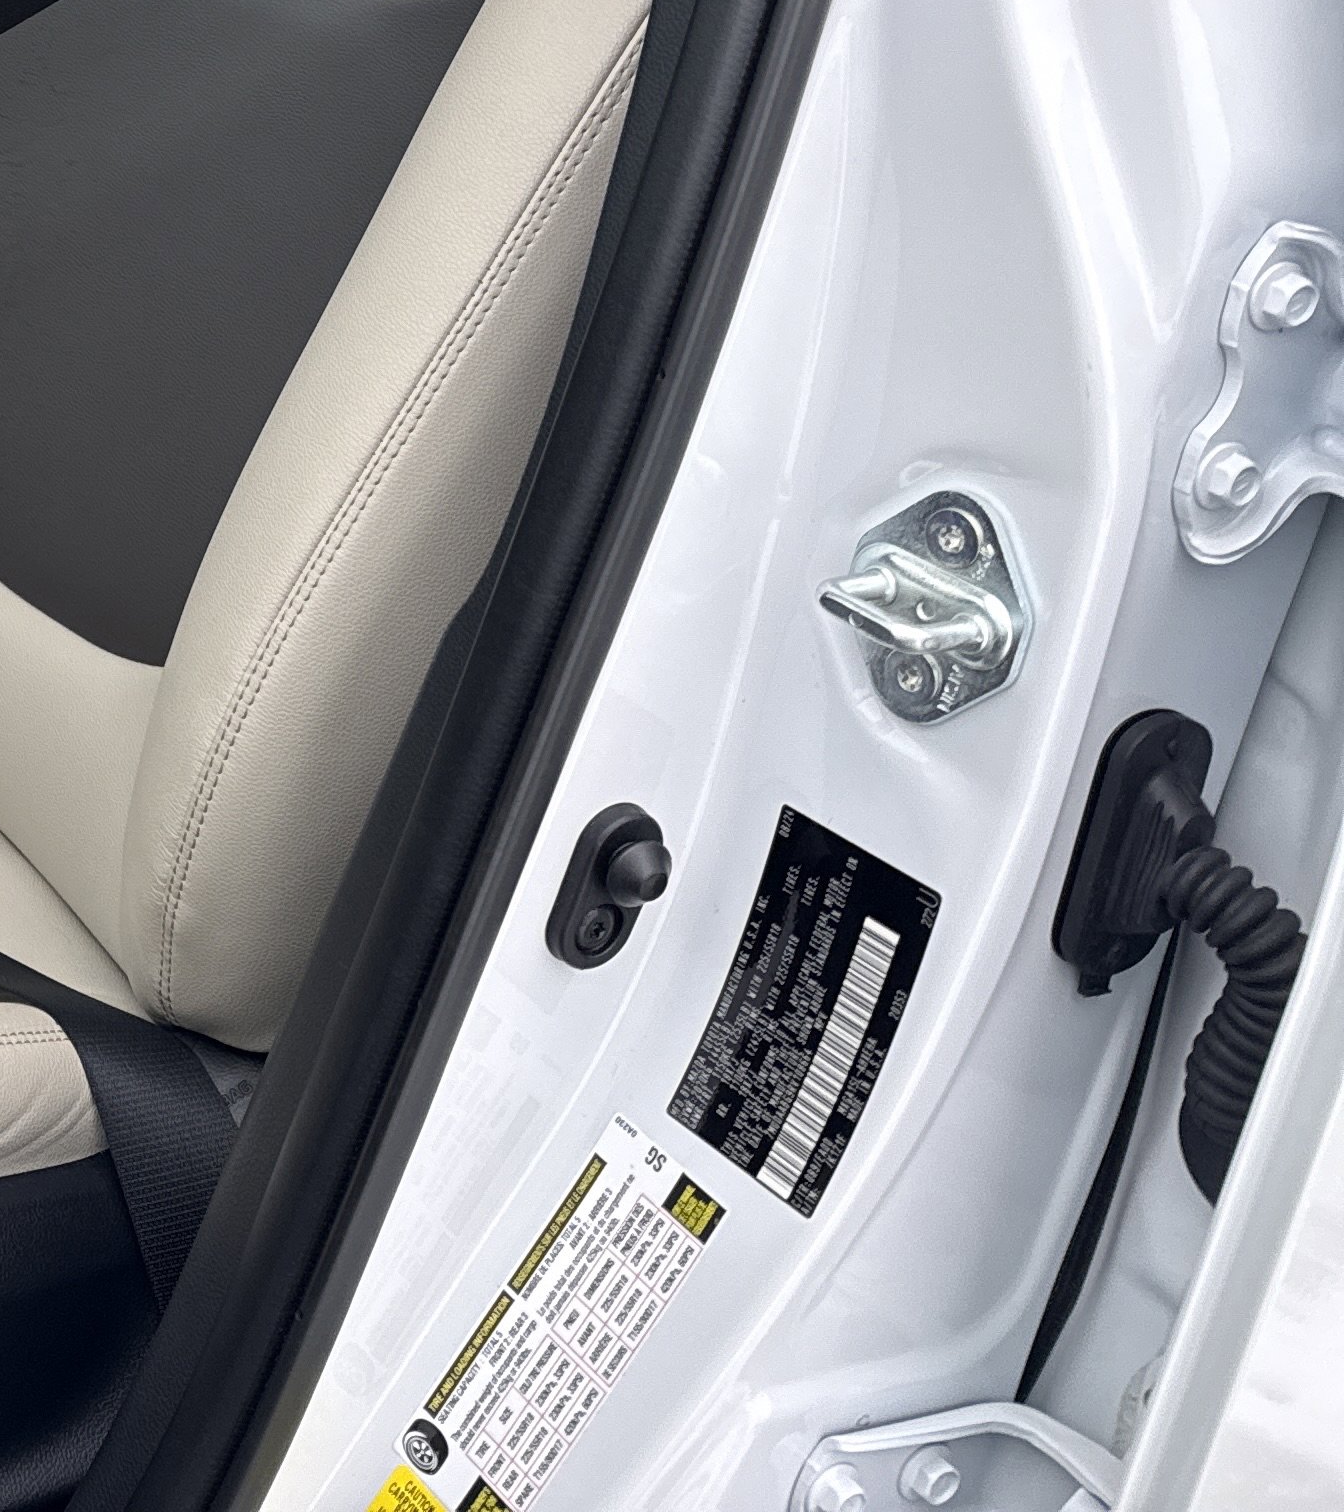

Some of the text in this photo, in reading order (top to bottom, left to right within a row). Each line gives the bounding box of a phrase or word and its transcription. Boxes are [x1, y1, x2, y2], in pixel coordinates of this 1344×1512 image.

[778, 808, 795, 839] 08/24
[746, 973, 763, 999] WITH
[755, 921, 782, 974] 225/55R18
[782, 859, 801, 896] TIRES.
[763, 984, 780, 1011] WITH
[773, 932, 800, 986] 225/55R18
[801, 871, 820, 907] TIRES.
[920, 905, 936, 929] 272
[700, 891, 770, 1053] TOYOTA MANUFACTURING U.S.A. INC.
[719, 1129, 739, 1155] THIS
[732, 1090, 758, 1130] VEHICLE
[752, 1043, 780, 1090] CONFORMS
[777, 1007, 793, 1028] ALL
[787, 949, 816, 1007] APPLICABLE
[808, 909, 829, 950] FEDERAL
[822, 875, 840, 908] MOTOR
[728, 854, 859, 1162] VEHICLE SAFETY AND THEFT PREVENTION STANDARDS IN EFFECT ON
[737, 982, 827, 1168] THE DATE OF MANUFACTURE SHOWN ABOVE
[846, 1094, 865, 1122] MADE
[856, 1078, 871, 1095] IN
[865, 1042, 886, 1080] U.S.A.
[887, 987, 907, 1021] 20353
[614, 1115, 638, 1138] 0A230
[645, 1145, 667, 1174] SG
[535, 1305, 546, 1317] Le
[541, 1288, 558, 1309] poids
[552, 1274, 566, 1291] total
[562, 1262, 575, 1277] des
[570, 1232, 596, 1267] occupants
[602, 1182, 631, 1220] chargement
[625, 1172, 636, 1185] ne
[547, 1222, 559, 1236] LES
[565, 1198, 576, 1210] ET
[568, 1226, 587, 1250] AVANT
[603, 1186, 613, 1196] 3
[569, 1190, 581, 1203] LE
[619, 1207, 655, 1257] PNEUS FROID
[520, 1272, 542, 1301] NOMBRE
[537, 1263, 548, 1276] DE
[560, 1220, 577, 1242] TOTAL
[543, 1308, 557, 1325] doit
[551, 1289, 571, 1313] jamais
[562, 1201, 645, 1330] PNEU DIMENSIONS PRESSION DES
[575, 1320, 597, 1348] AVANT
[599, 1273, 630, 1313] 225/55R18
[647, 1216, 666, 1240] 33PSI
[613, 1286, 643, 1326] 225/55R18
[661, 1229, 680, 1253] 33PSI
[676, 1244, 695, 1268] 60PSI
[427, 1294, 511, 1413] TIRE AND LOADING INFORMATION
[436, 1329, 503, 1425] SEATING CAPACITY TOTAL 5
[450, 1427, 462, 1442] The
[456, 1400, 481, 1432] combined
[476, 1380, 495, 1404] weight
[493, 1346, 519, 1379] occupants
[513, 1334, 526, 1350] and
[522, 1318, 538, 1339] cargo
[487, 1310, 529, 1368] FRONT REAR 3
[458, 1428, 476, 1451] should
[471, 1412, 487, 1432] never
[482, 1391, 501, 1415] exceed
[509, 1367, 517, 1377] or
[474, 1340, 558, 1459] TIRE SIZE COLD TIRE PRESSURE
[486, 1452, 507, 1479] FRONT
[505, 1411, 536, 1451] 225/55R18
[551, 1357, 571, 1381] 33PSI
[501, 1468, 520, 1492] REAR
[519, 1425, 550, 1465] 225/55R18
[565, 1370, 585, 1395] 33PSI
[513, 1481, 535, 1508] SPARE
[580, 1386, 600, 1411] 60PSI
